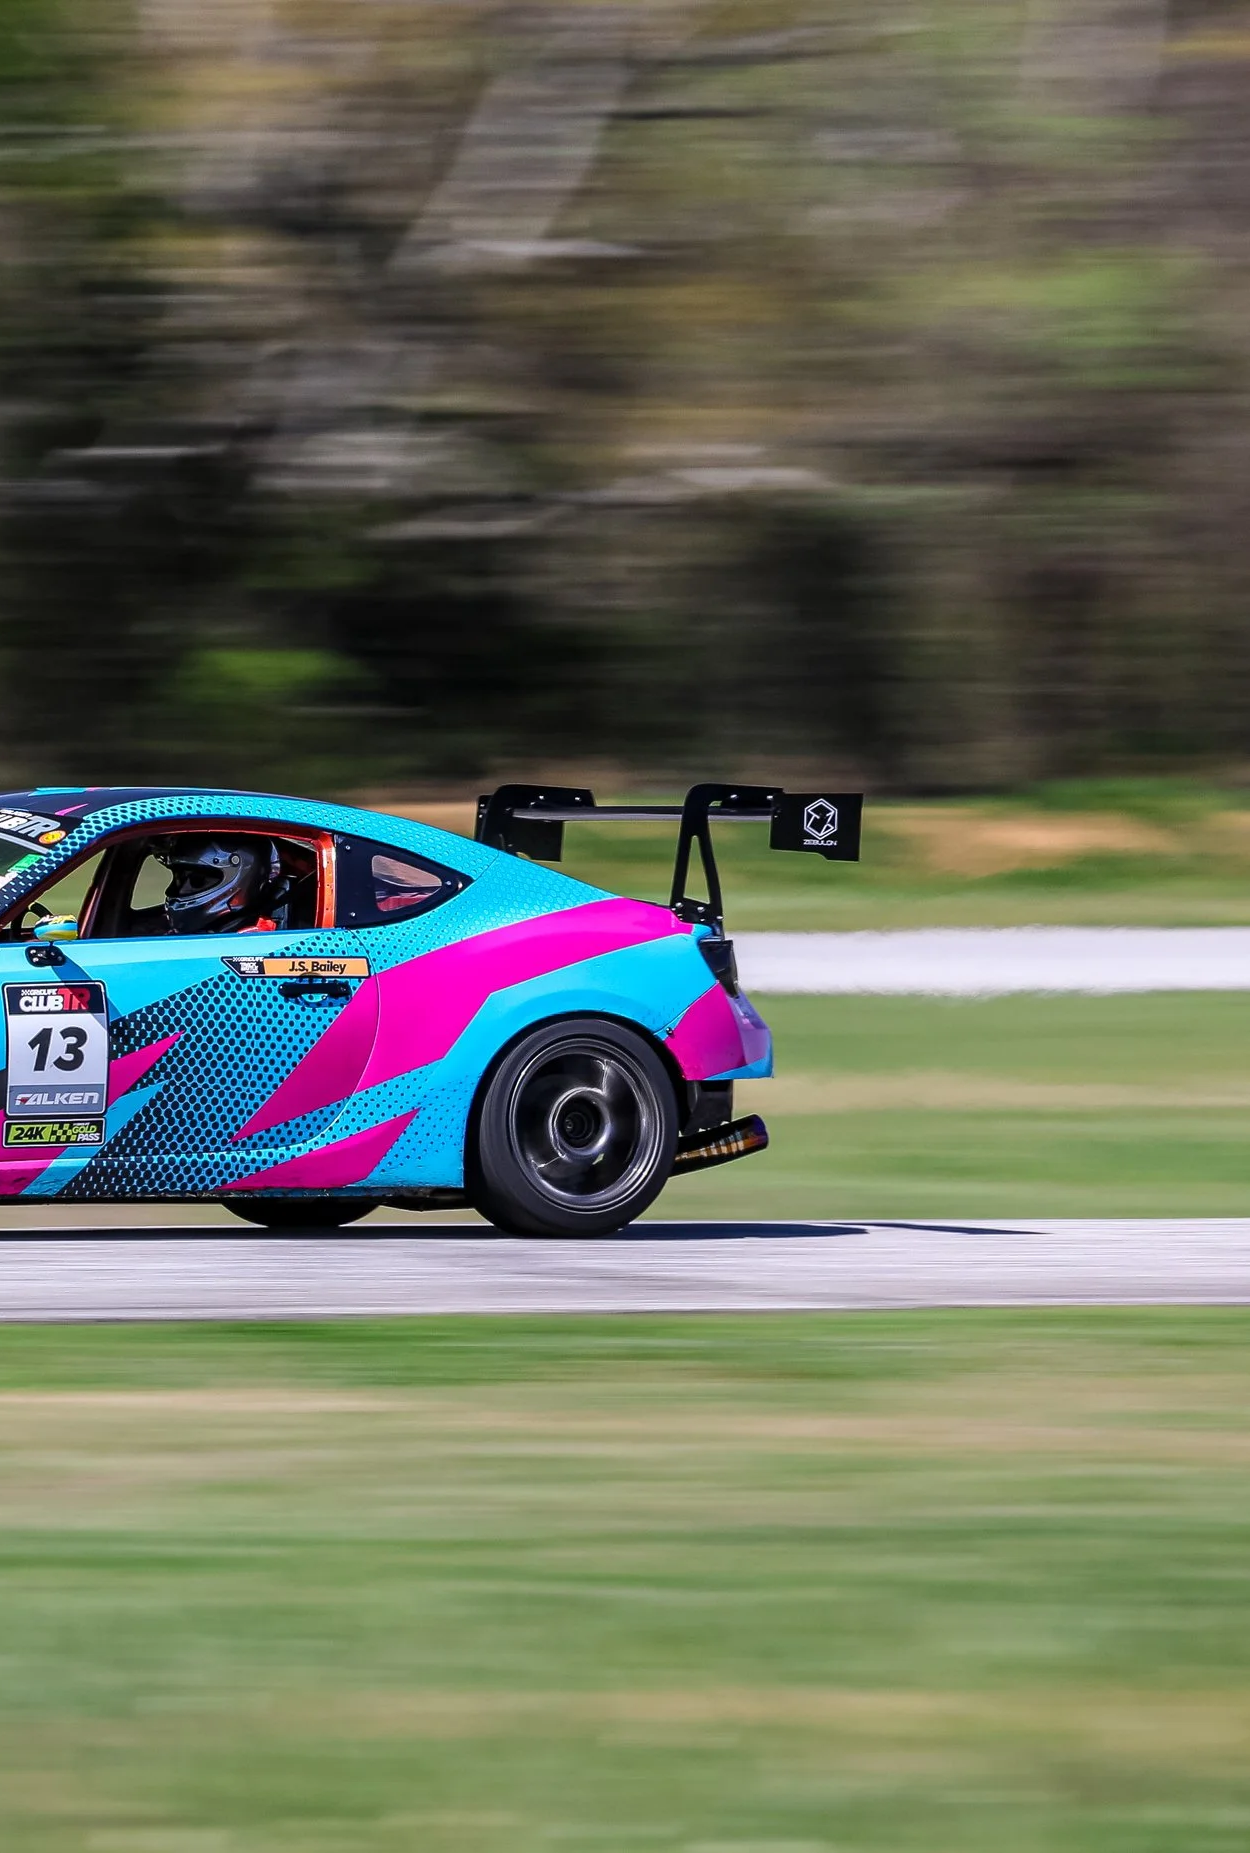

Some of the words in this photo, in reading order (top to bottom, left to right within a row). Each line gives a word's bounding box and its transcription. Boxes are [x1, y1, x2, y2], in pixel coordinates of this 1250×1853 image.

[288, 962, 309, 972] J.S.
[312, 961, 347, 974] Bailey
[27, 1026, 88, 1072] 13
[14, 1092, 100, 1106] FALKEN
[12, 1126, 47, 1141] 24K
[72, 1125, 98, 1134] GOLD
[77, 1133, 101, 1142] PASS
